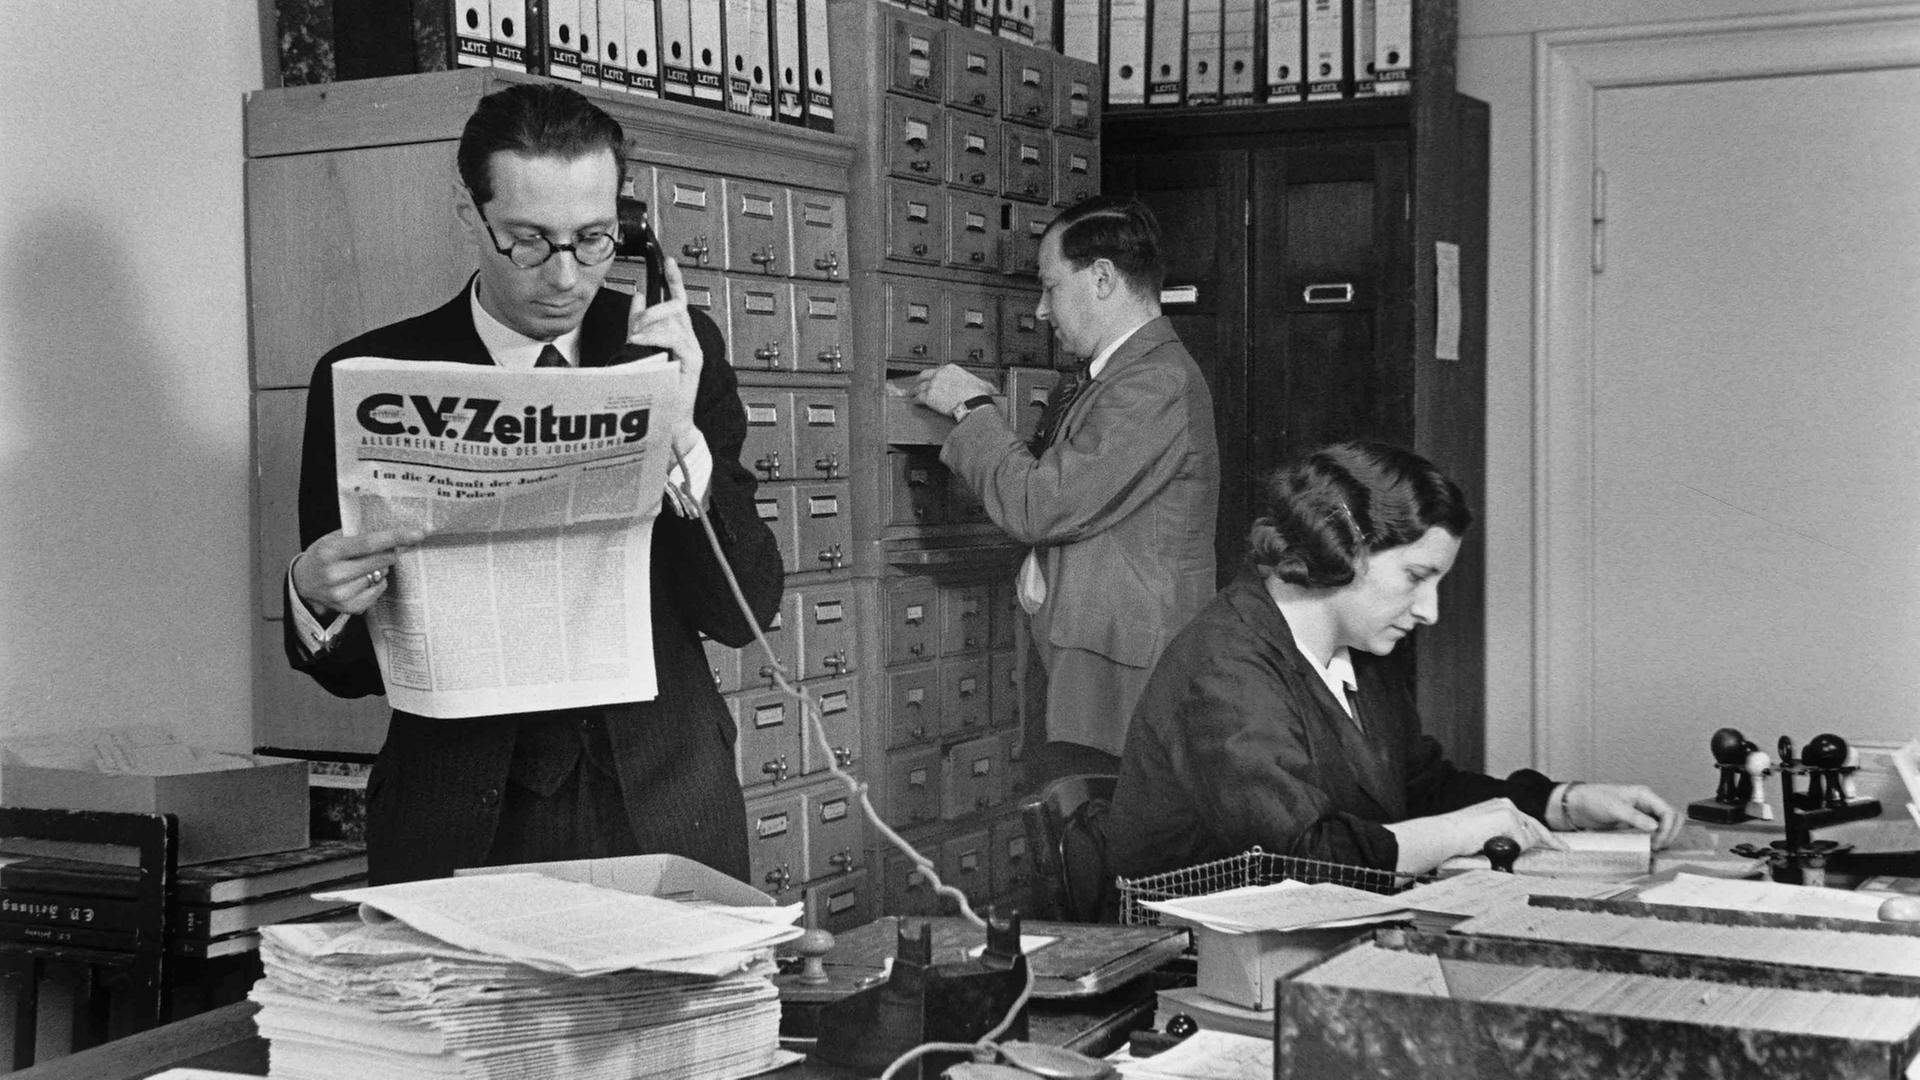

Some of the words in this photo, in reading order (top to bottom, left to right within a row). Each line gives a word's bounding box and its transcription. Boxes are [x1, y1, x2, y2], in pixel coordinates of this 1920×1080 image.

[461, 39, 488, 55] LEITZ
[496, 45, 522, 61] LEITZ
[553, 51, 579, 65] LEITZ
[581, 62, 597, 75] EITZ
[603, 67, 625, 81] LEITZ
[667, 68, 689, 83] LEITZ
[631, 73, 655, 89] LEITZ
[697, 72, 720, 87] LEITZ
[1154, 84, 1177, 93] LEITZ
[1272, 84, 1298, 94] LEITZ
[1311, 83, 1338, 93] LEITZ
[811, 91, 830, 105] LEITZ
[361, 436, 446, 451] ALLGEMEINE
[454, 442, 508, 457] ZEITUNG
[516, 446, 538, 457] DES
[401, 471, 423, 482] die
[427, 475, 484, 489] Zukunft
[489, 479, 512, 488] der
[437, 487, 451, 497] in
